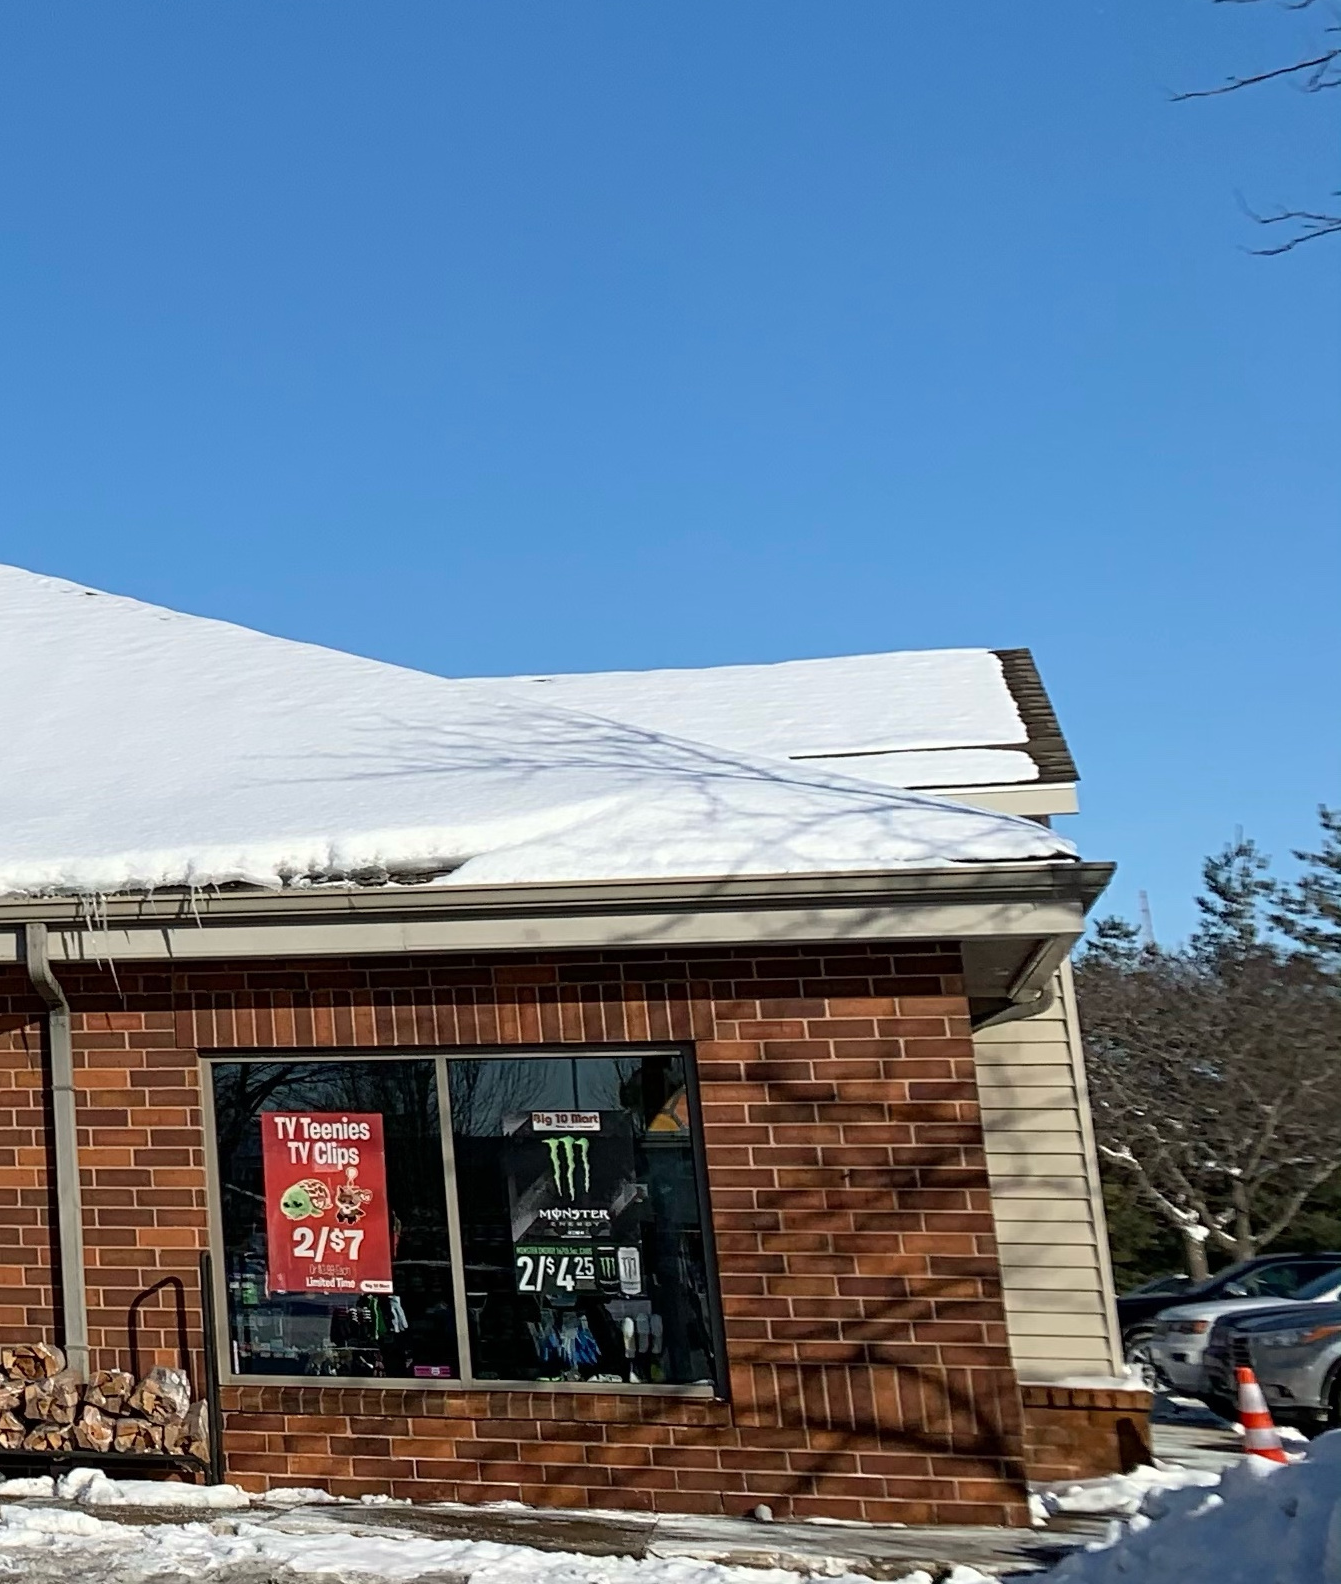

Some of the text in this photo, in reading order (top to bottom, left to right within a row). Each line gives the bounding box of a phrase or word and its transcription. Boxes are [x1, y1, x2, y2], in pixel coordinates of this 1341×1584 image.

[274, 1116, 371, 1140] TY Teenies
[533, 1113, 599, 1126] Big 10 Mart
[287, 1141, 360, 1171] TY Clips
[539, 1207, 610, 1220] MONSTER
[292, 1226, 365, 1263] 2/$7
[306, 1277, 355, 1288] Limited Time
